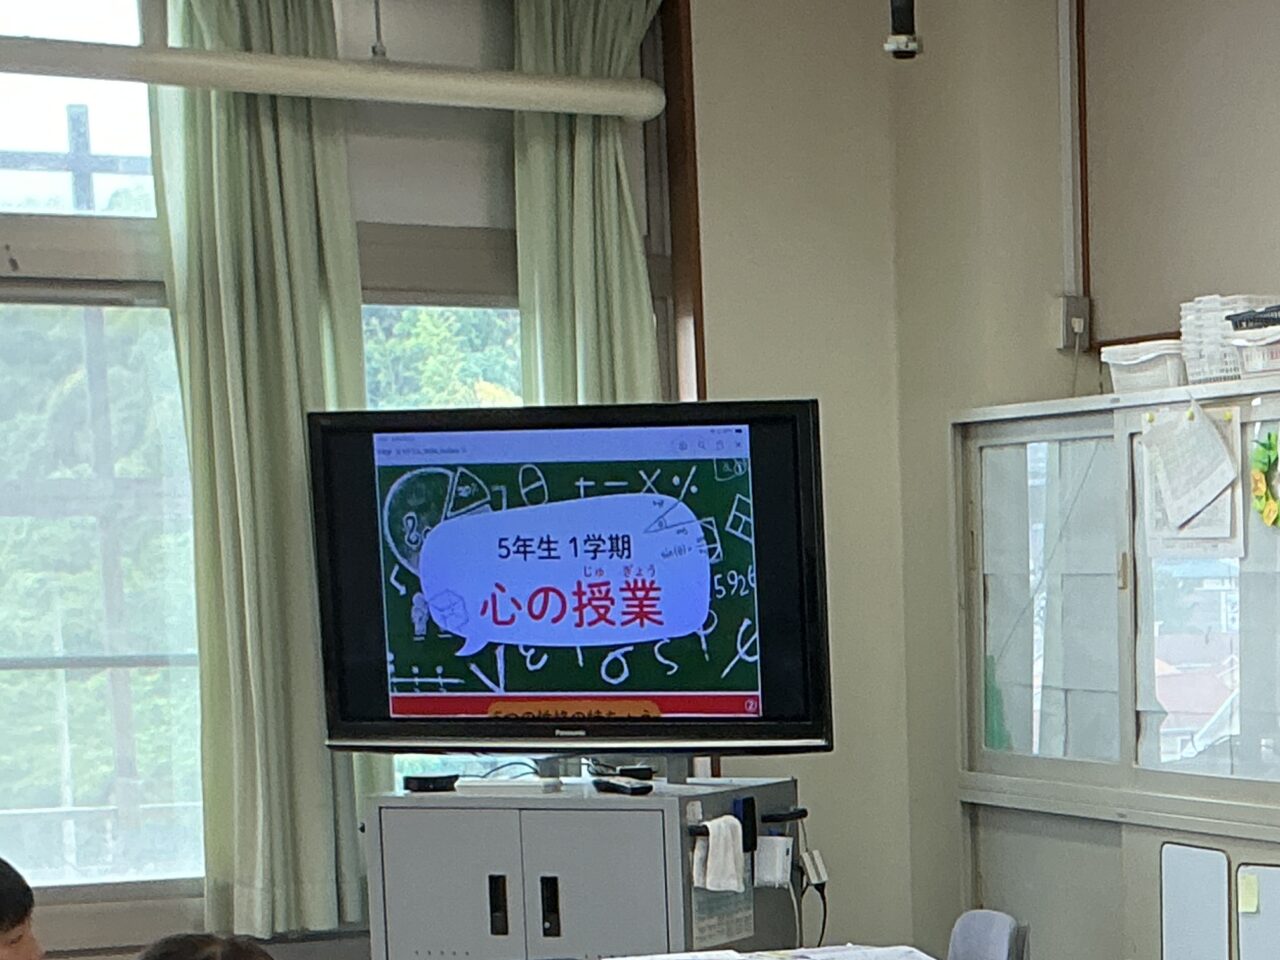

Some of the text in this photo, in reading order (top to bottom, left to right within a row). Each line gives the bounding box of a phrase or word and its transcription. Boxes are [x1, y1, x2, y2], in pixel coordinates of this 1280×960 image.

[498, 533, 632, 561] 5年生 1学期
[479, 577, 665, 628] 心の授業
